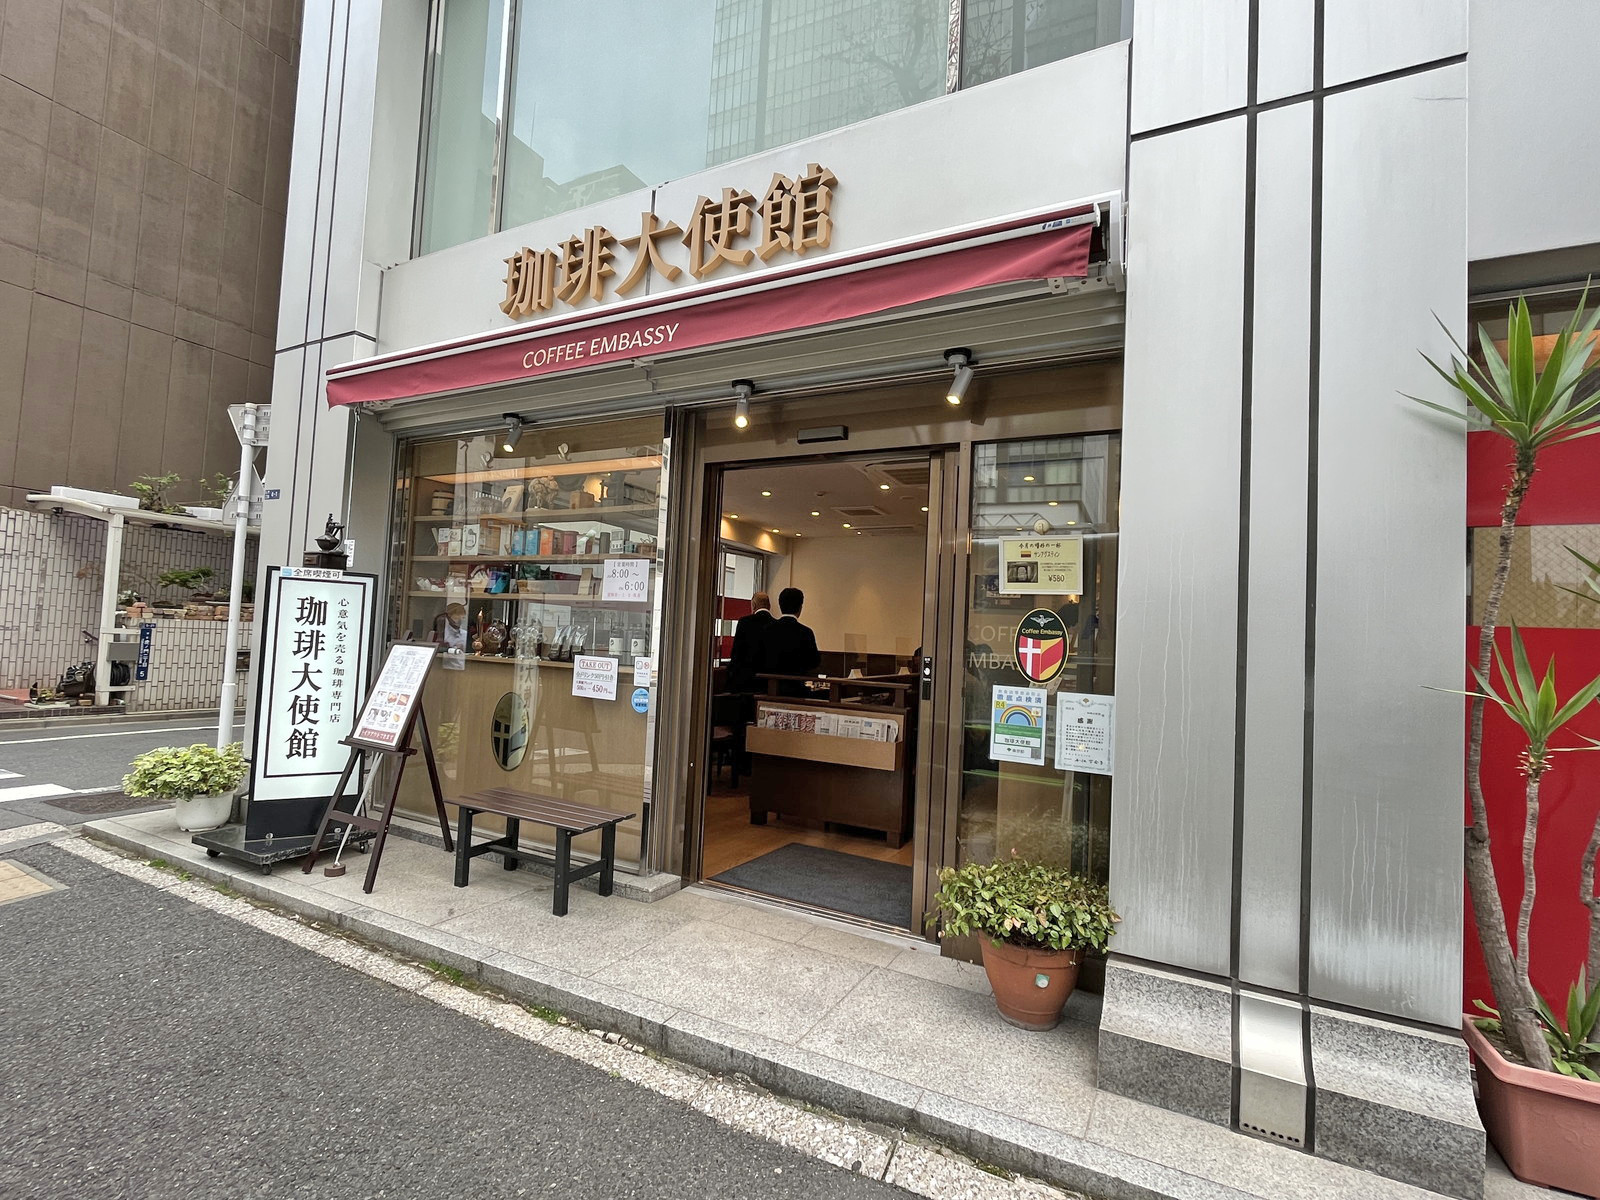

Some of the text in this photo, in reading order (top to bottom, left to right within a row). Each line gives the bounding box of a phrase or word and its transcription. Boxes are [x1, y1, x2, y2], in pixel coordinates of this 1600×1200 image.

[498, 163, 839, 319] 珈琲大使館
[522, 322, 680, 369] COFFEE EMBASSY
[293, 568, 341, 579] 全席喫煙可
[139, 670, 145, 678] 5
[284, 596, 329, 760] 珈琲大使館
[329, 598, 350, 723] 心意気を売る珈琲専門店
[581, 660, 610, 670] TAKE OUT
